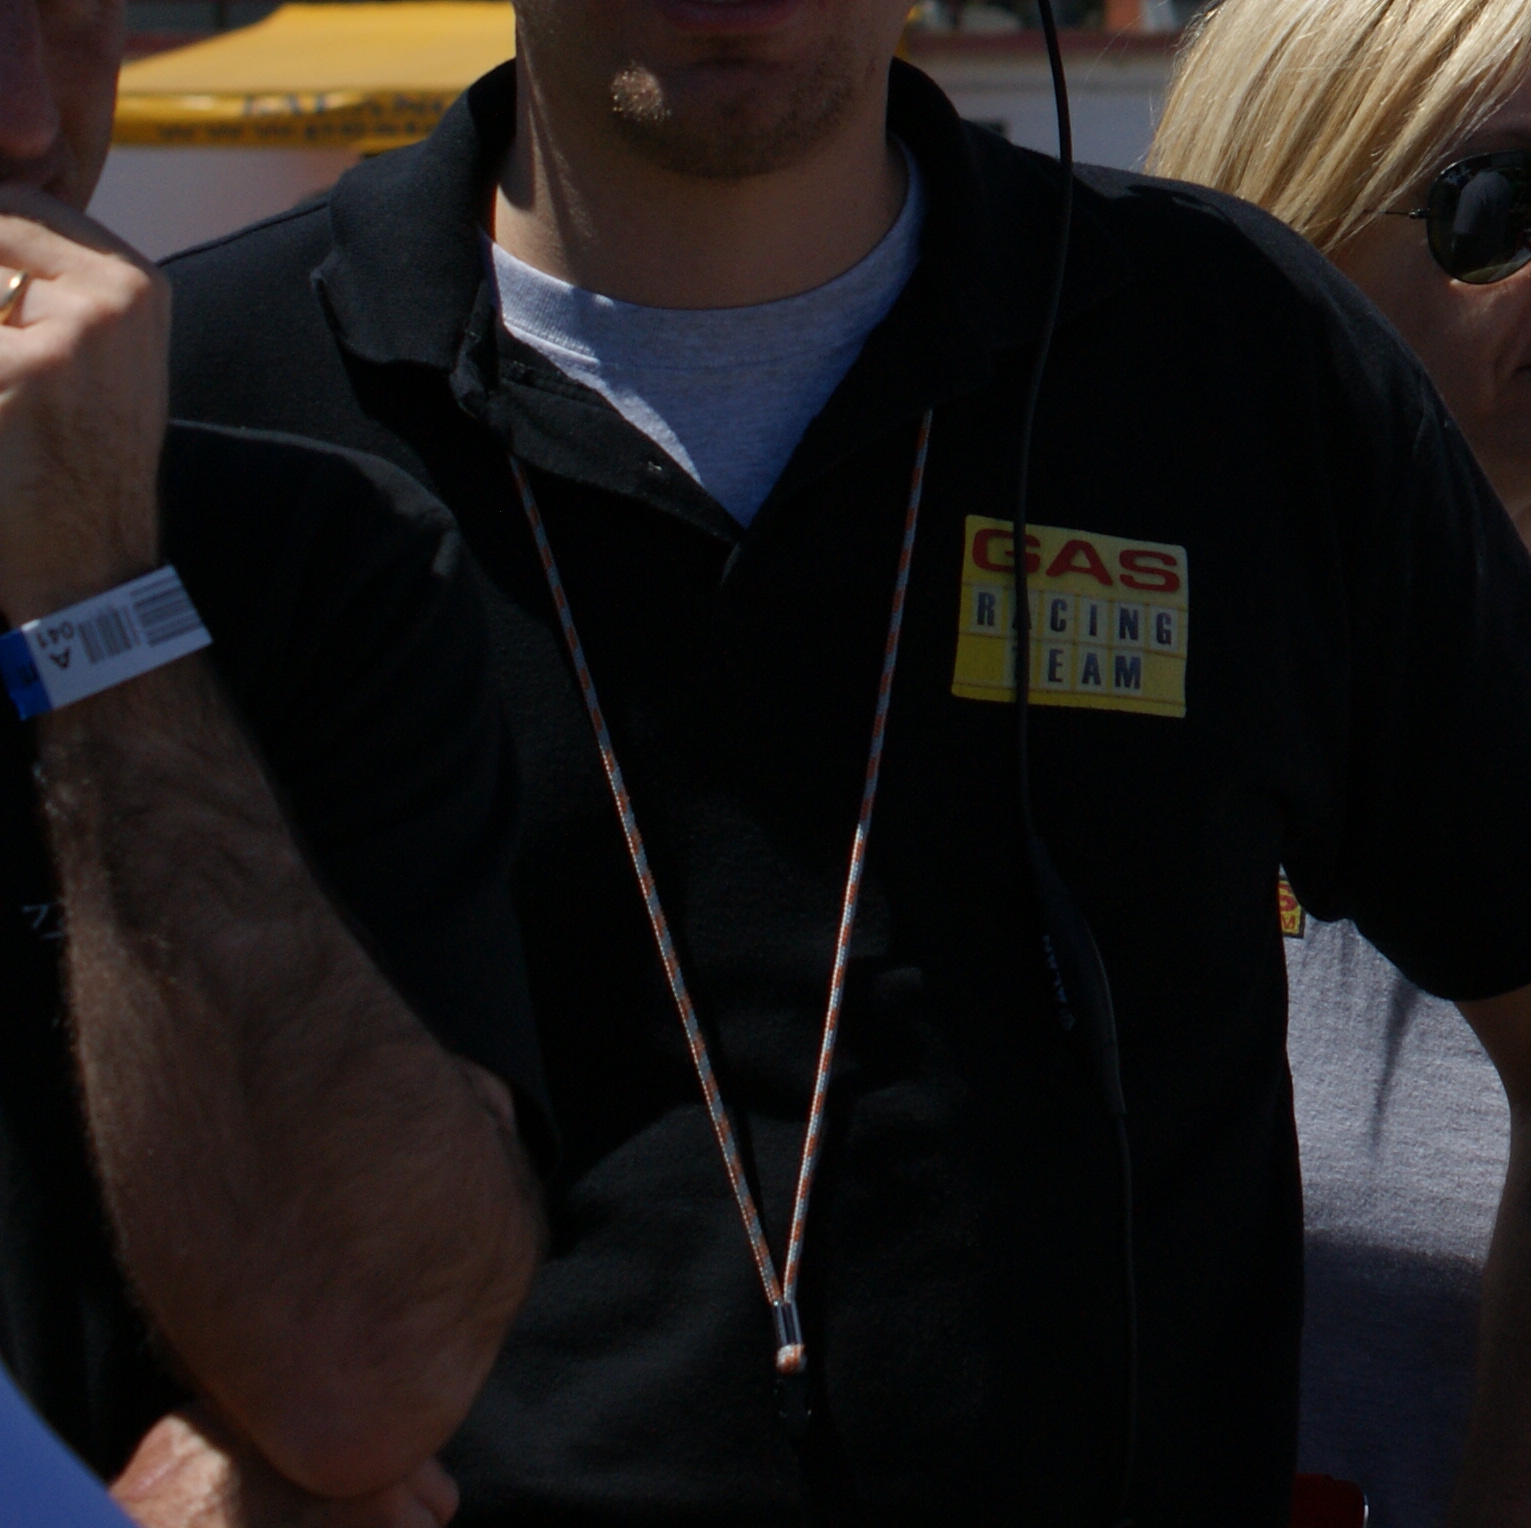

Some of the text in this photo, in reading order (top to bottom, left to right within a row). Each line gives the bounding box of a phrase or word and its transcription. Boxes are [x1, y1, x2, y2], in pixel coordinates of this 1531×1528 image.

[971, 527, 1180, 593] GAS
[976, 591, 1172, 646] RCING
[1012, 644, 1142, 690] EAM
